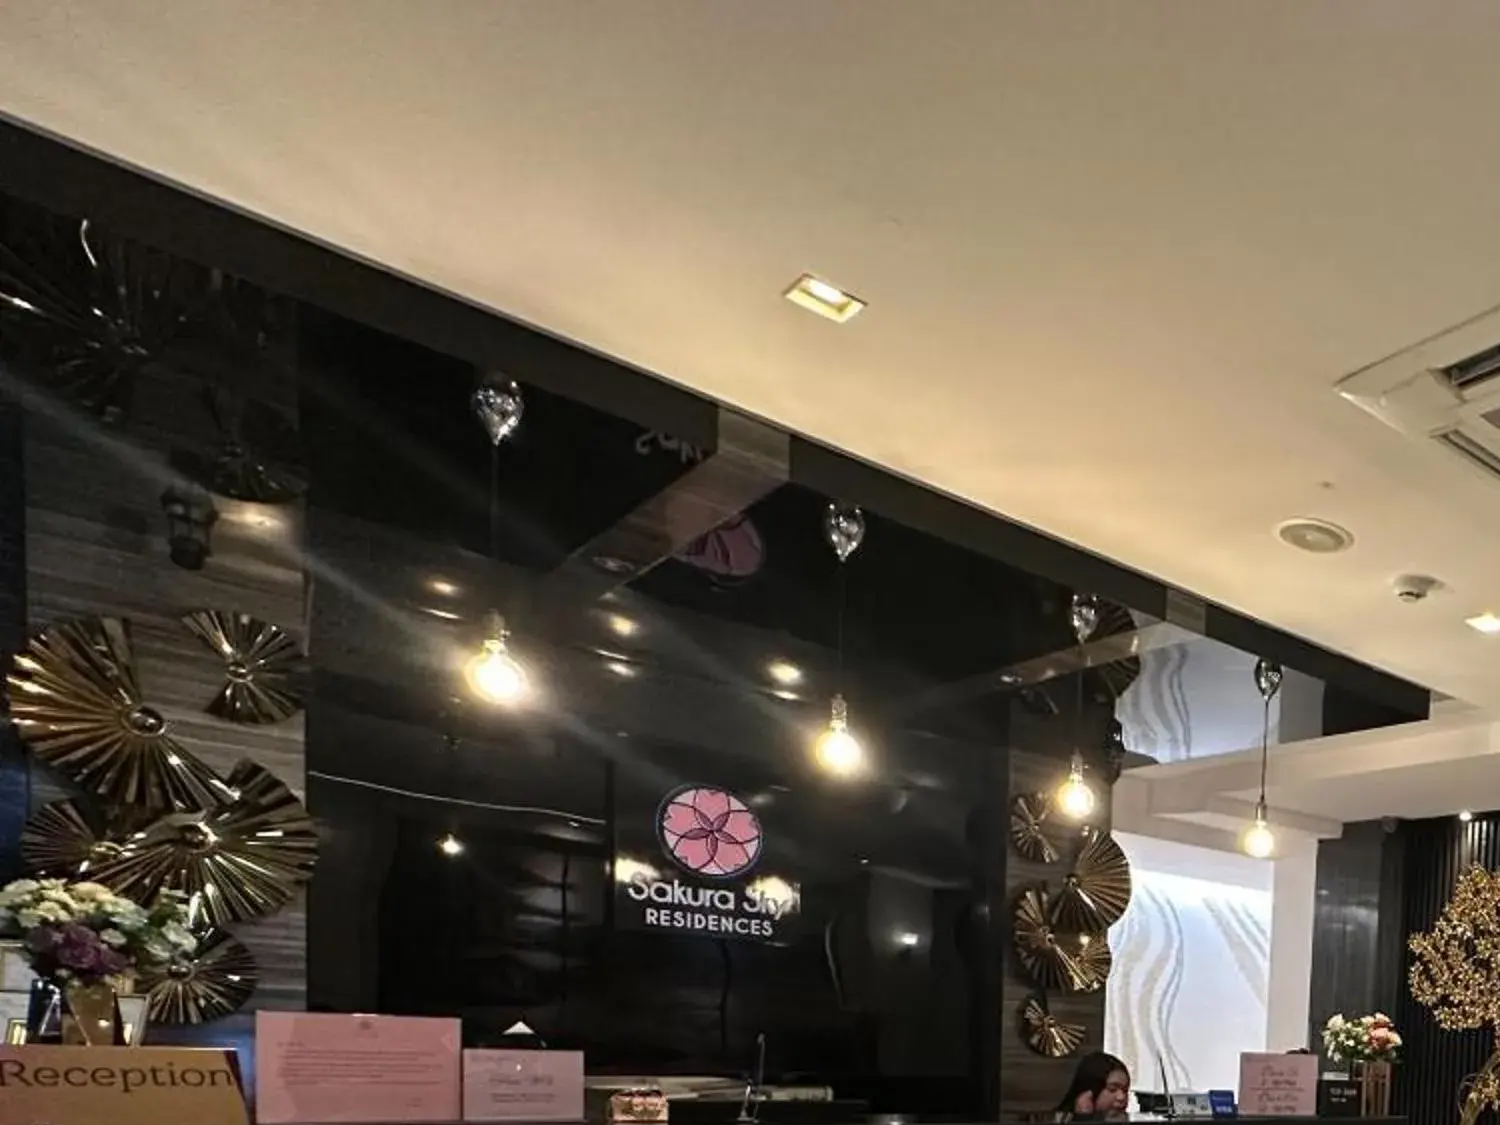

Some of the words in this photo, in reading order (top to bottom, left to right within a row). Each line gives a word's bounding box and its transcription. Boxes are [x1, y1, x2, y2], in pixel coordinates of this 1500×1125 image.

[628, 871, 735, 910] Sakura
[645, 908, 774, 936] RESIDENCES
[0, 1059, 234, 1093] Reception
